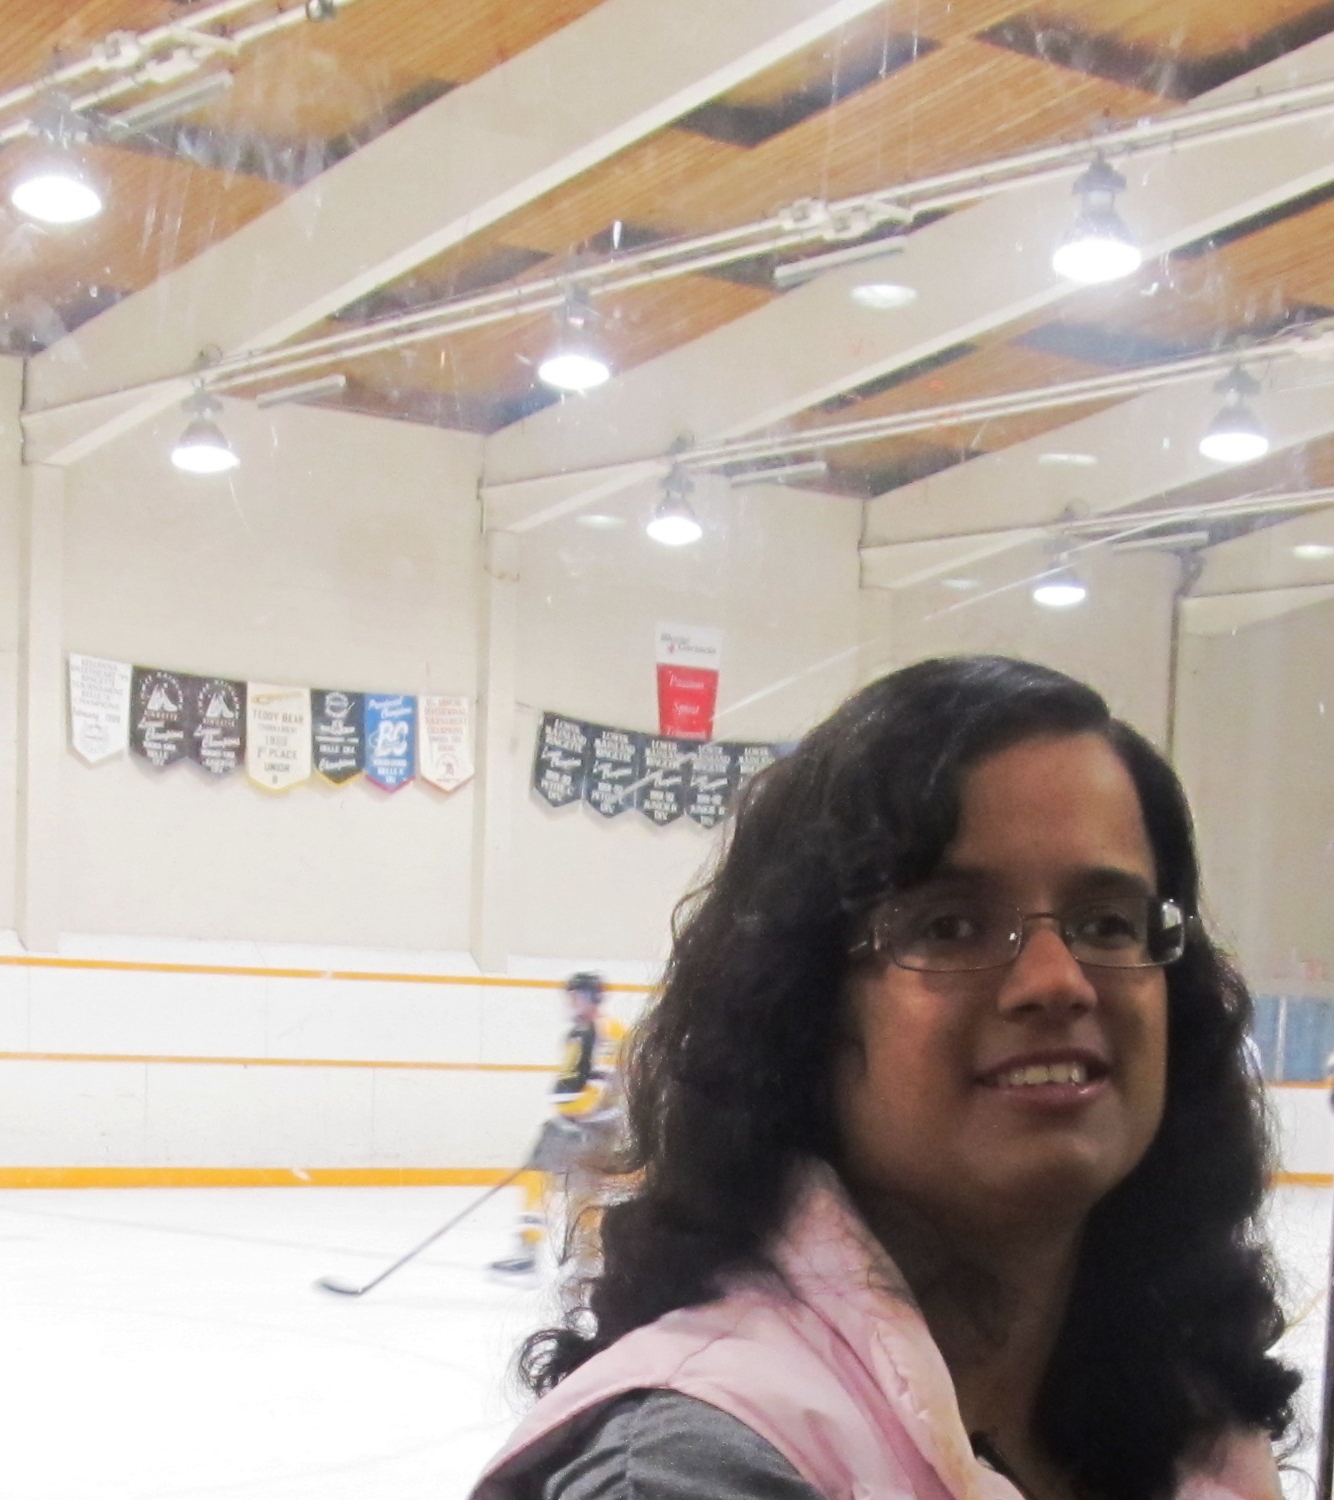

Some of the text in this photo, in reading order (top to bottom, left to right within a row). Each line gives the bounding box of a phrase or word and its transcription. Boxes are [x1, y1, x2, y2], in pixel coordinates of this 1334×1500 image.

[253, 709, 304, 725] TEDDY BEAR
[268, 748, 298, 760] PLACE
